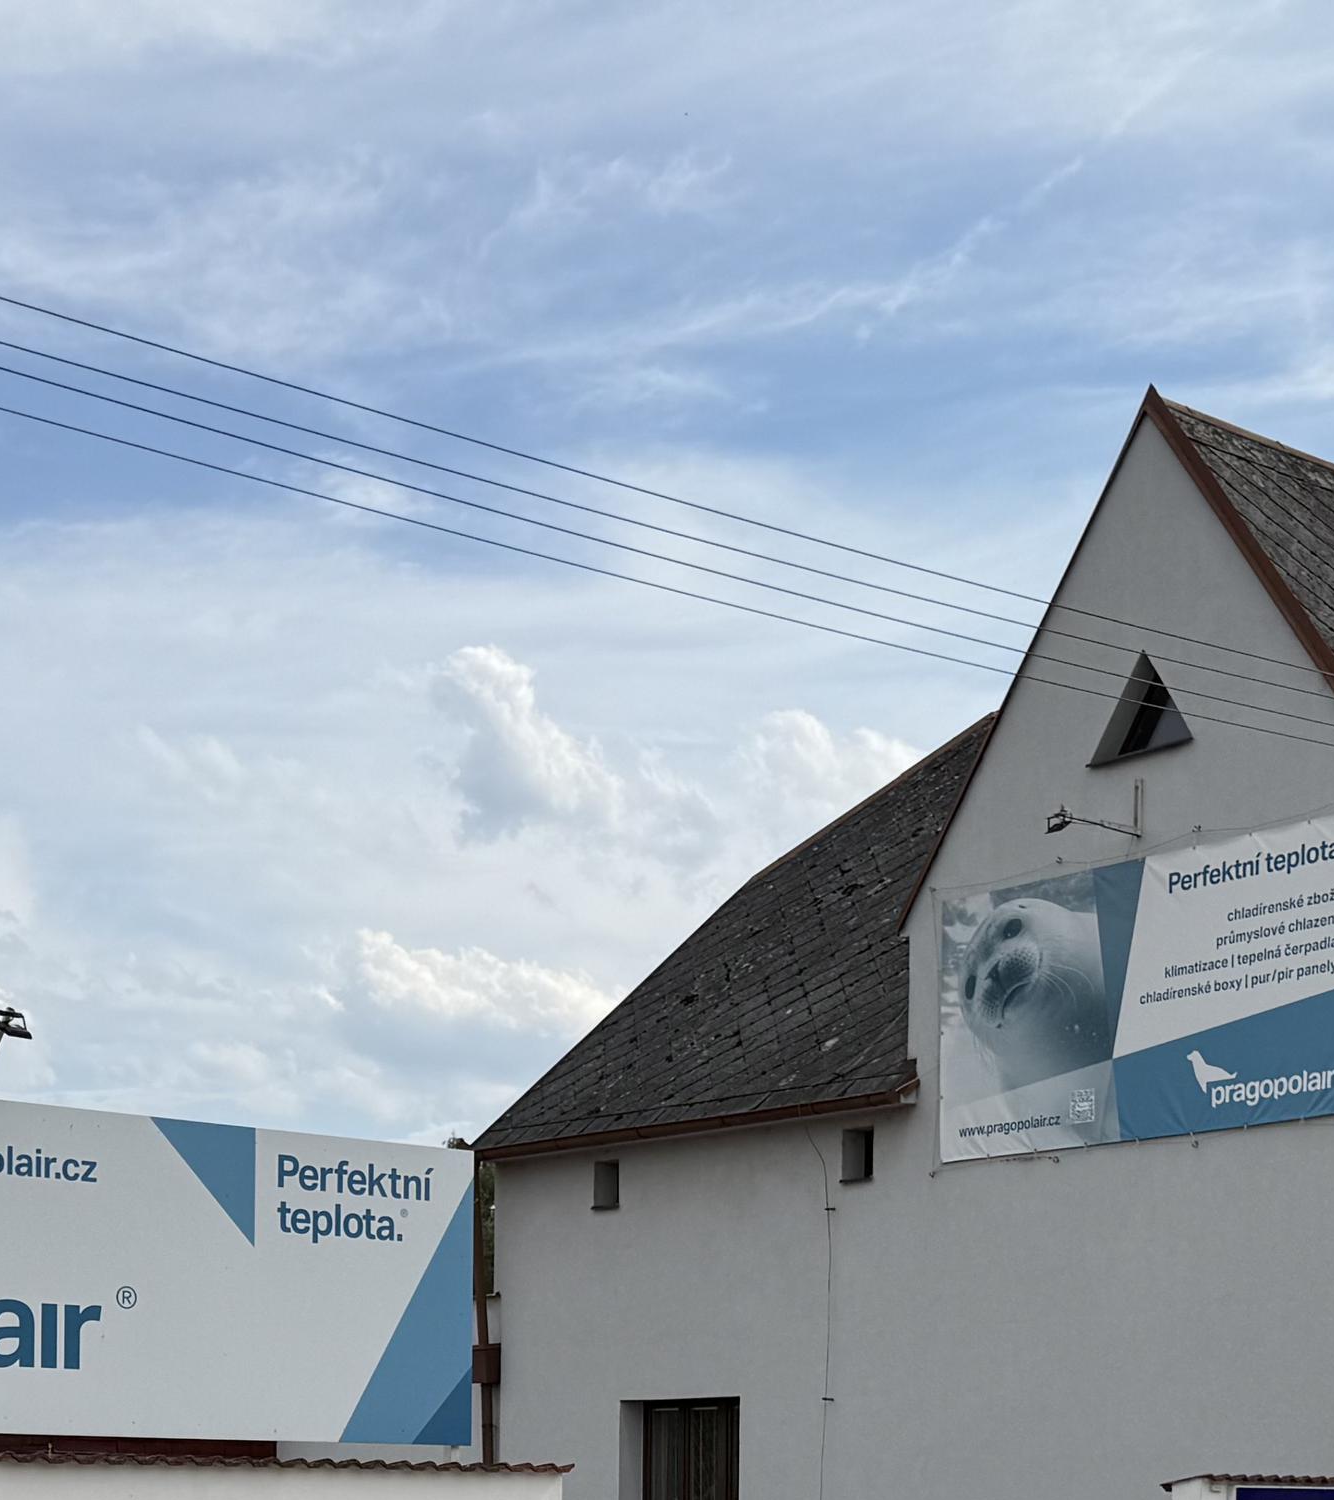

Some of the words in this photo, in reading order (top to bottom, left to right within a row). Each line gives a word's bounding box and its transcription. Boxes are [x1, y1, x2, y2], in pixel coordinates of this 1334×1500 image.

[1168, 851, 1261, 893] Perfektní
[1227, 895, 1305, 922] chladírenské
[1216, 921, 1286, 949] průmyslové
[1164, 957, 1228, 979] klimatizace
[1237, 942, 1282, 966] tepelná
[1139, 980, 1212, 1004] chladírenské
[1214, 977, 1243, 992] boxy
[1251, 967, 1292, 988] pur/pir
[958, 1113, 1061, 1138] www.pragopolair.cz
[276, 1153, 434, 1201] Perfektní
[276, 1200, 404, 1244] teplota.
